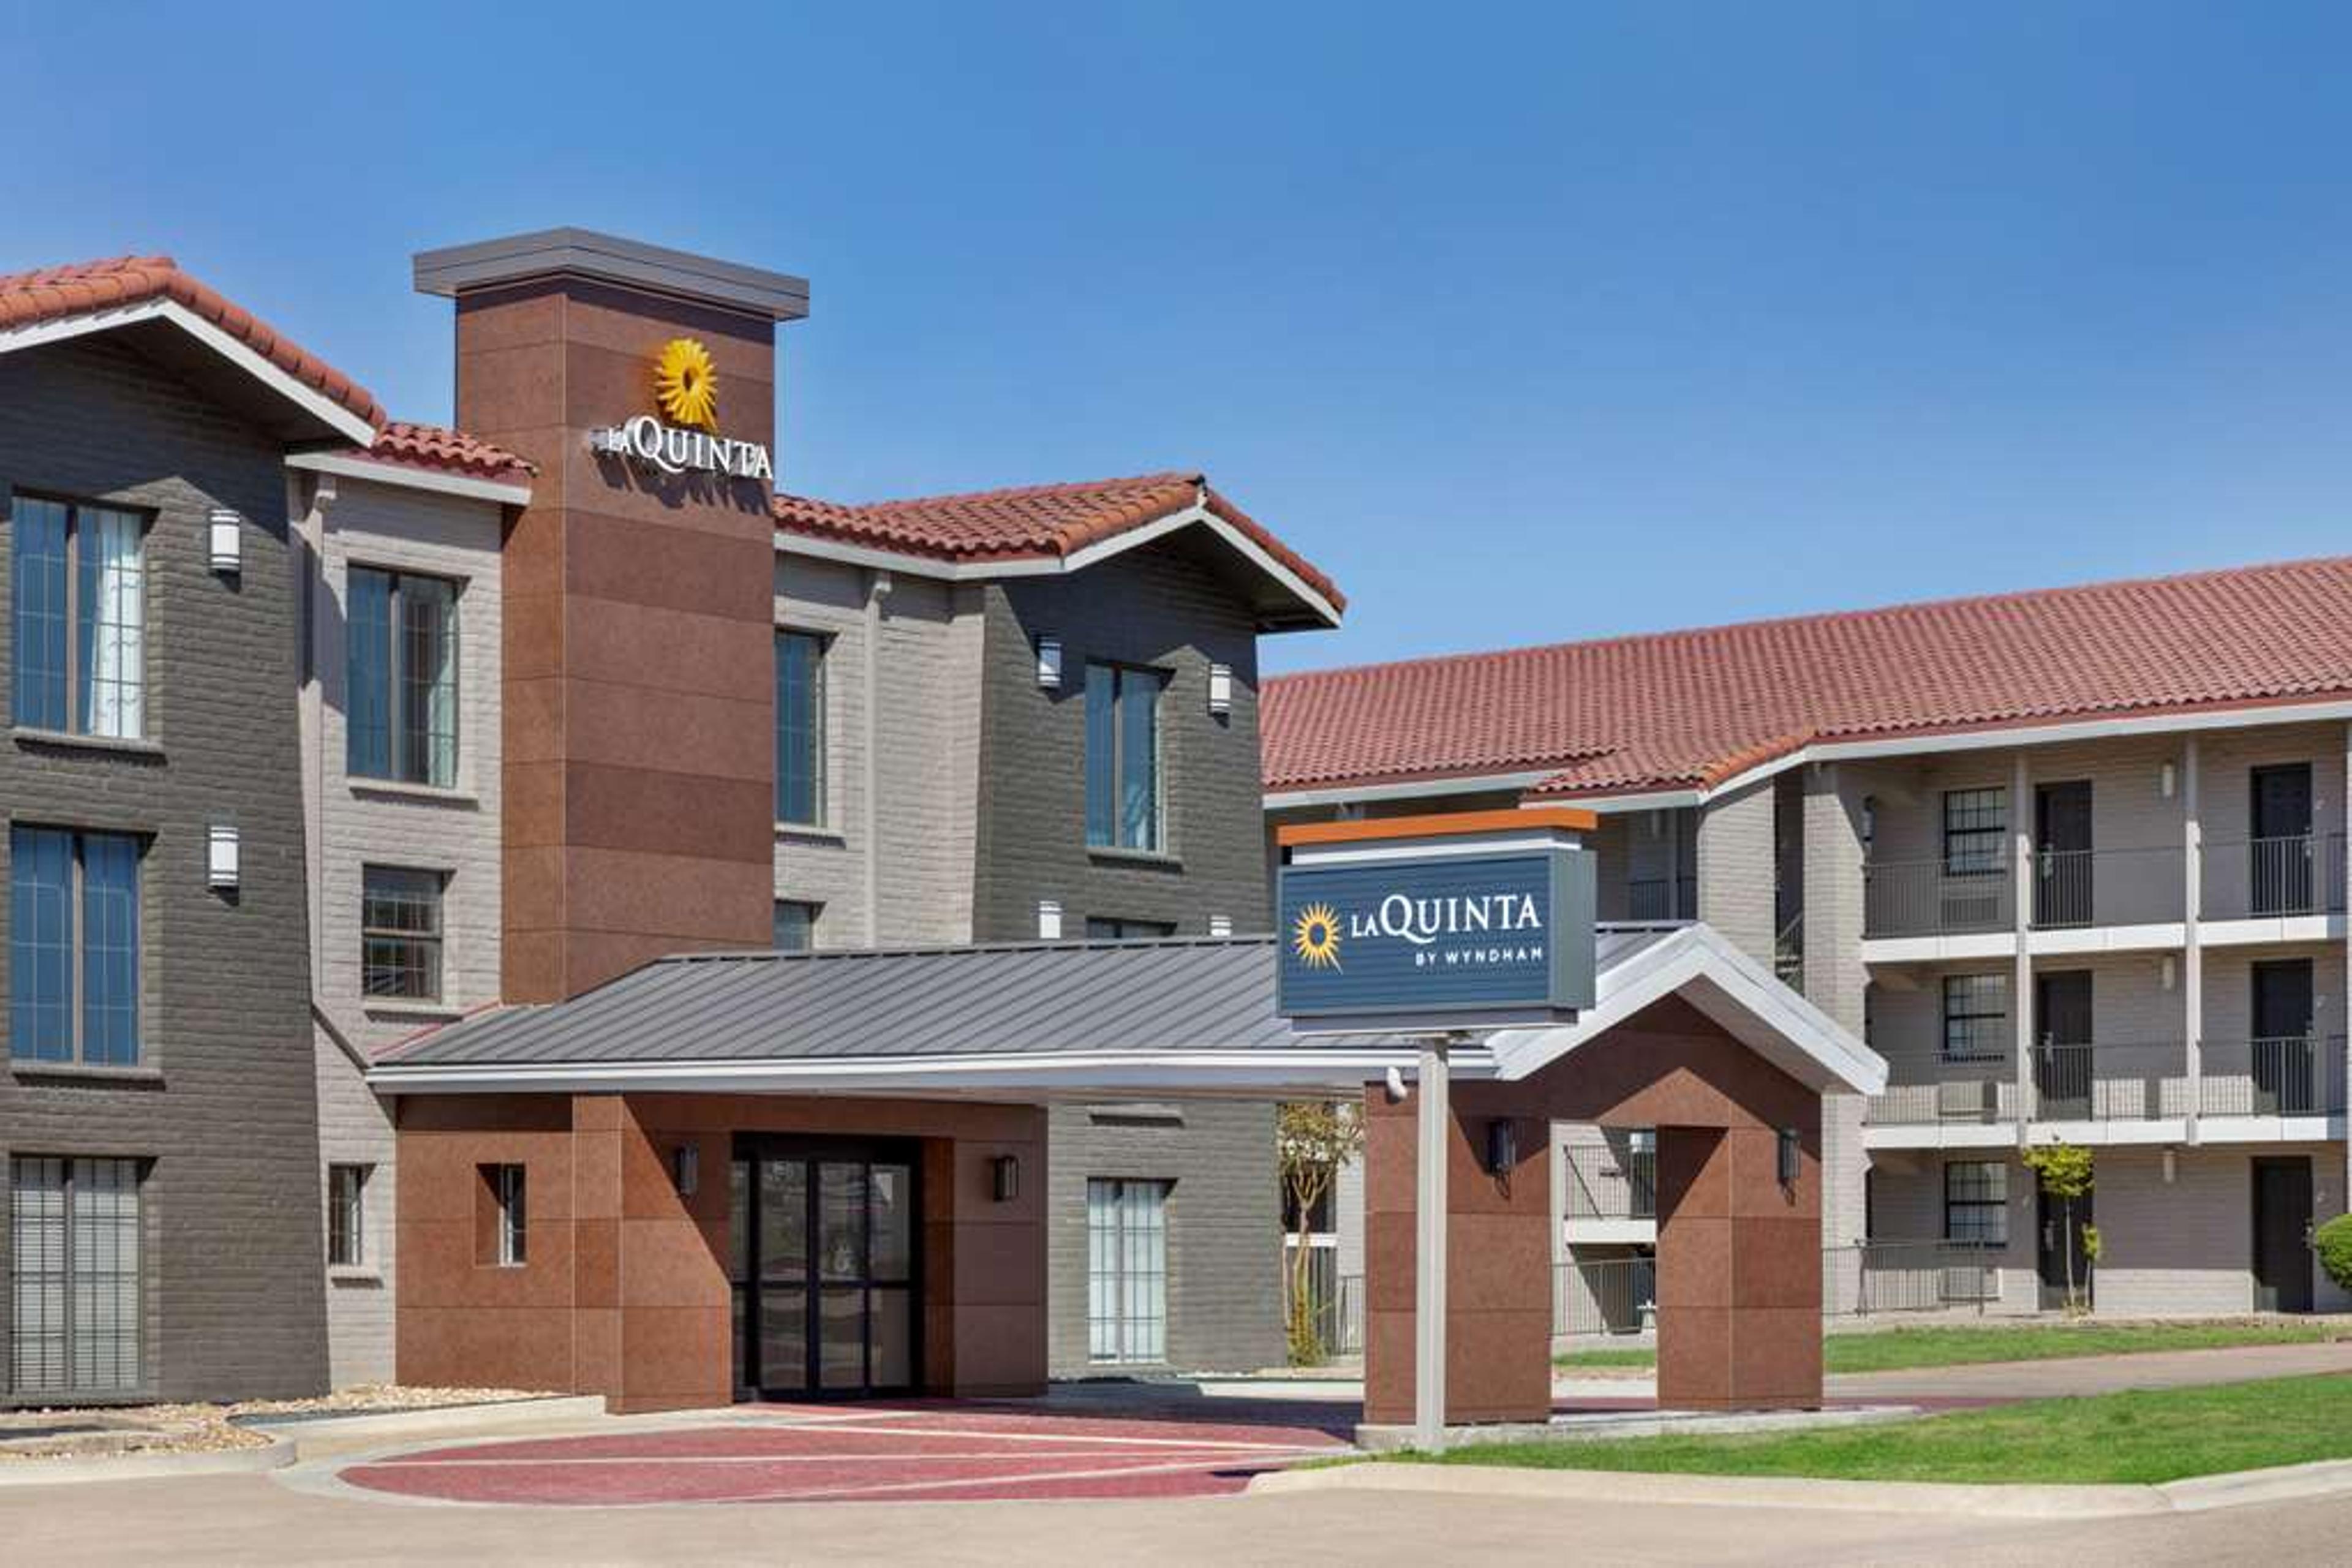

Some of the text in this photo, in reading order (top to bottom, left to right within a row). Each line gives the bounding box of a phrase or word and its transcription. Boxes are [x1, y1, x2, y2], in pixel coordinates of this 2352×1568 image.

[608, 415, 773, 480] LA QUINTA
[1351, 894, 1543, 944] LA QUINTA
[1415, 947, 1543, 966] BY WYNDHAM
